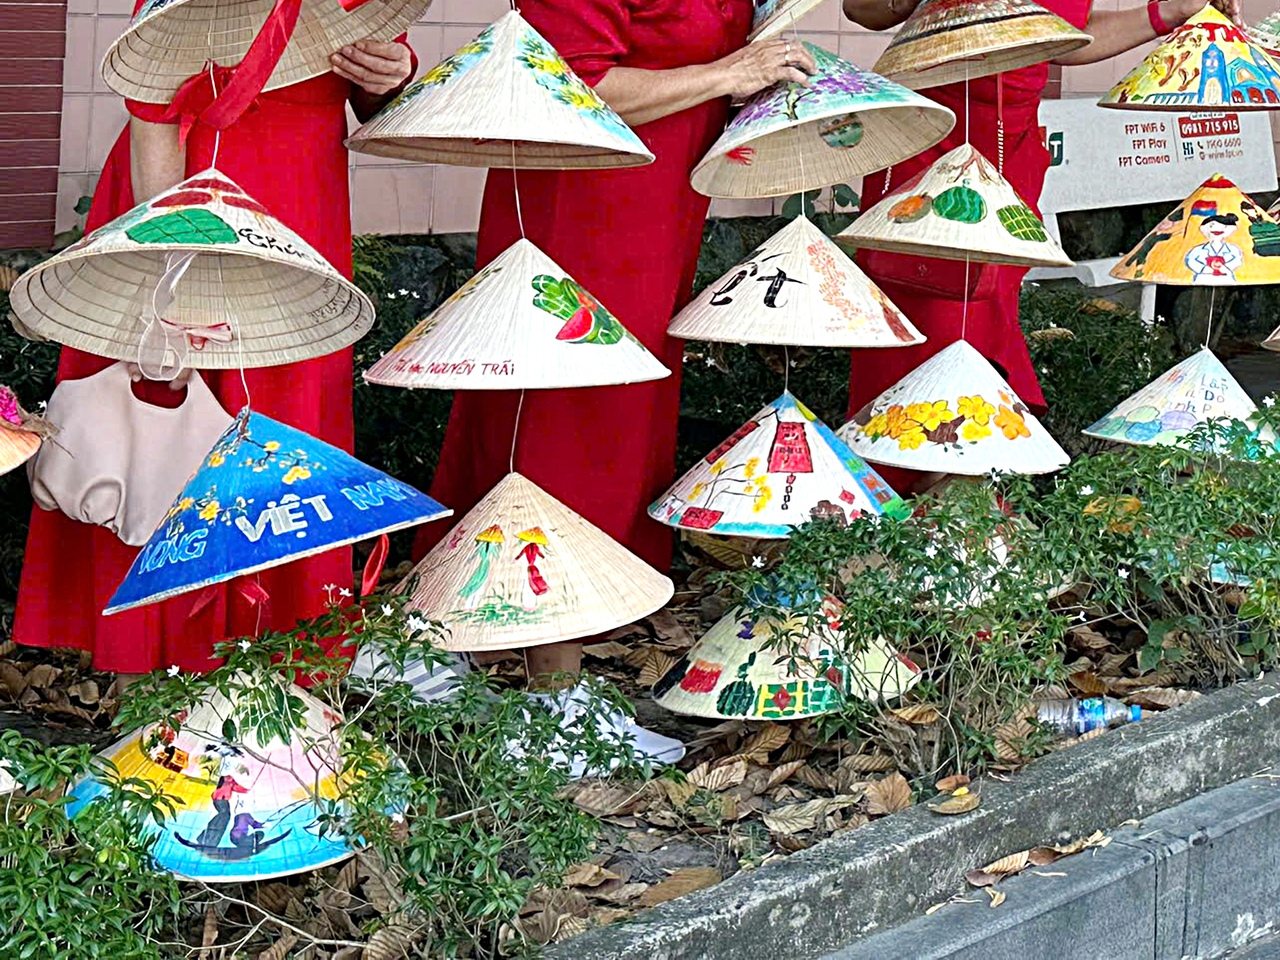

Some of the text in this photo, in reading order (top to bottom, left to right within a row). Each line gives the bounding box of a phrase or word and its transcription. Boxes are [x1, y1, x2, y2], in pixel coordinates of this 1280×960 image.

[1125, 124, 1140, 135] FPT
[1205, 120, 1221, 133] 715
[1222, 119, 1239, 131] 915
[1132, 137, 1168, 150] FPT Play
[1119, 155, 1171, 168] FPT Camera
[234, 493, 334, 542] VIỆT
